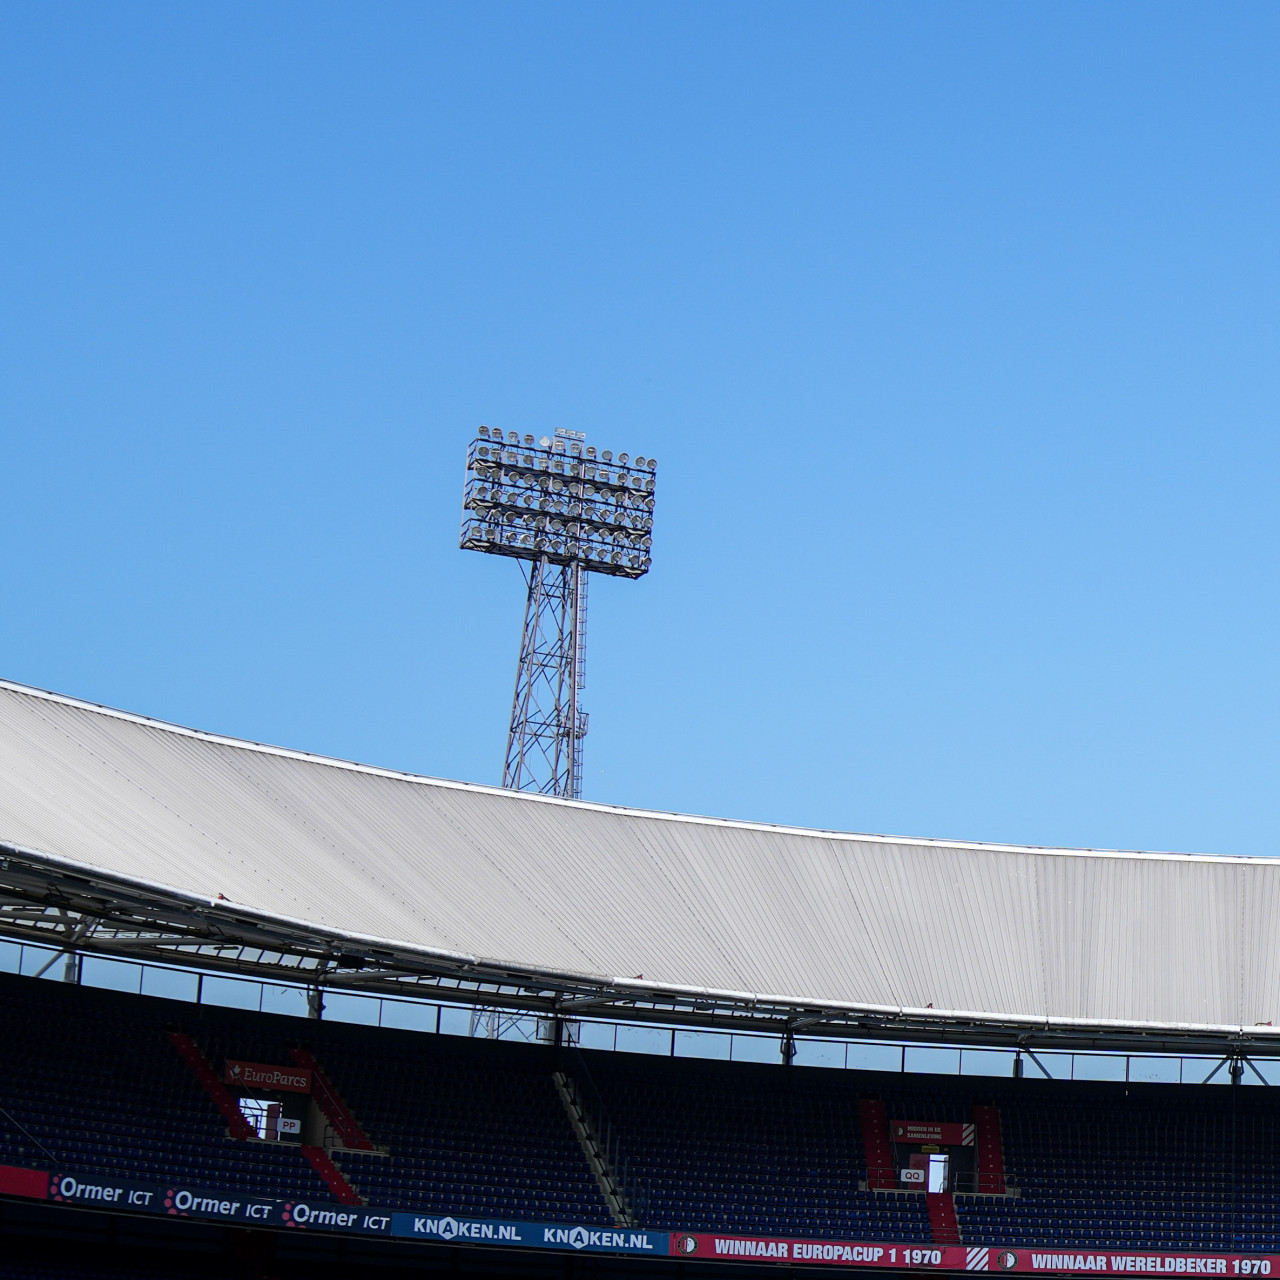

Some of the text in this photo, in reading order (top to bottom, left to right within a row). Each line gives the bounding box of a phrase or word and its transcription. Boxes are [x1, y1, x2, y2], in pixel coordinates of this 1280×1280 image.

[243, 1067, 307, 1087] EuroParcs
[282, 1121, 296, 1130] PP
[905, 1171, 920, 1181] QQ
[60, 1177, 153, 1206] Ormer ICT
[175, 1190, 272, 1219] Ormer ICT
[293, 1204, 390, 1230] Ormer ICT
[414, 1216, 521, 1241] KNAKEN.NL
[544, 1226, 653, 1250] KNAKEN.NL
[715, 1238, 788, 1258] WINNAAR
[793, 1243, 884, 1263] EUROPACUP
[889, 1248, 897, 1263] 1
[903, 1249, 942, 1265] 1970
[1032, 1254, 1107, 1271] WINNAAR
[1111, 1256, 1226, 1274] WERELDBEKER
[1232, 1259, 1271, 1275] 1970
